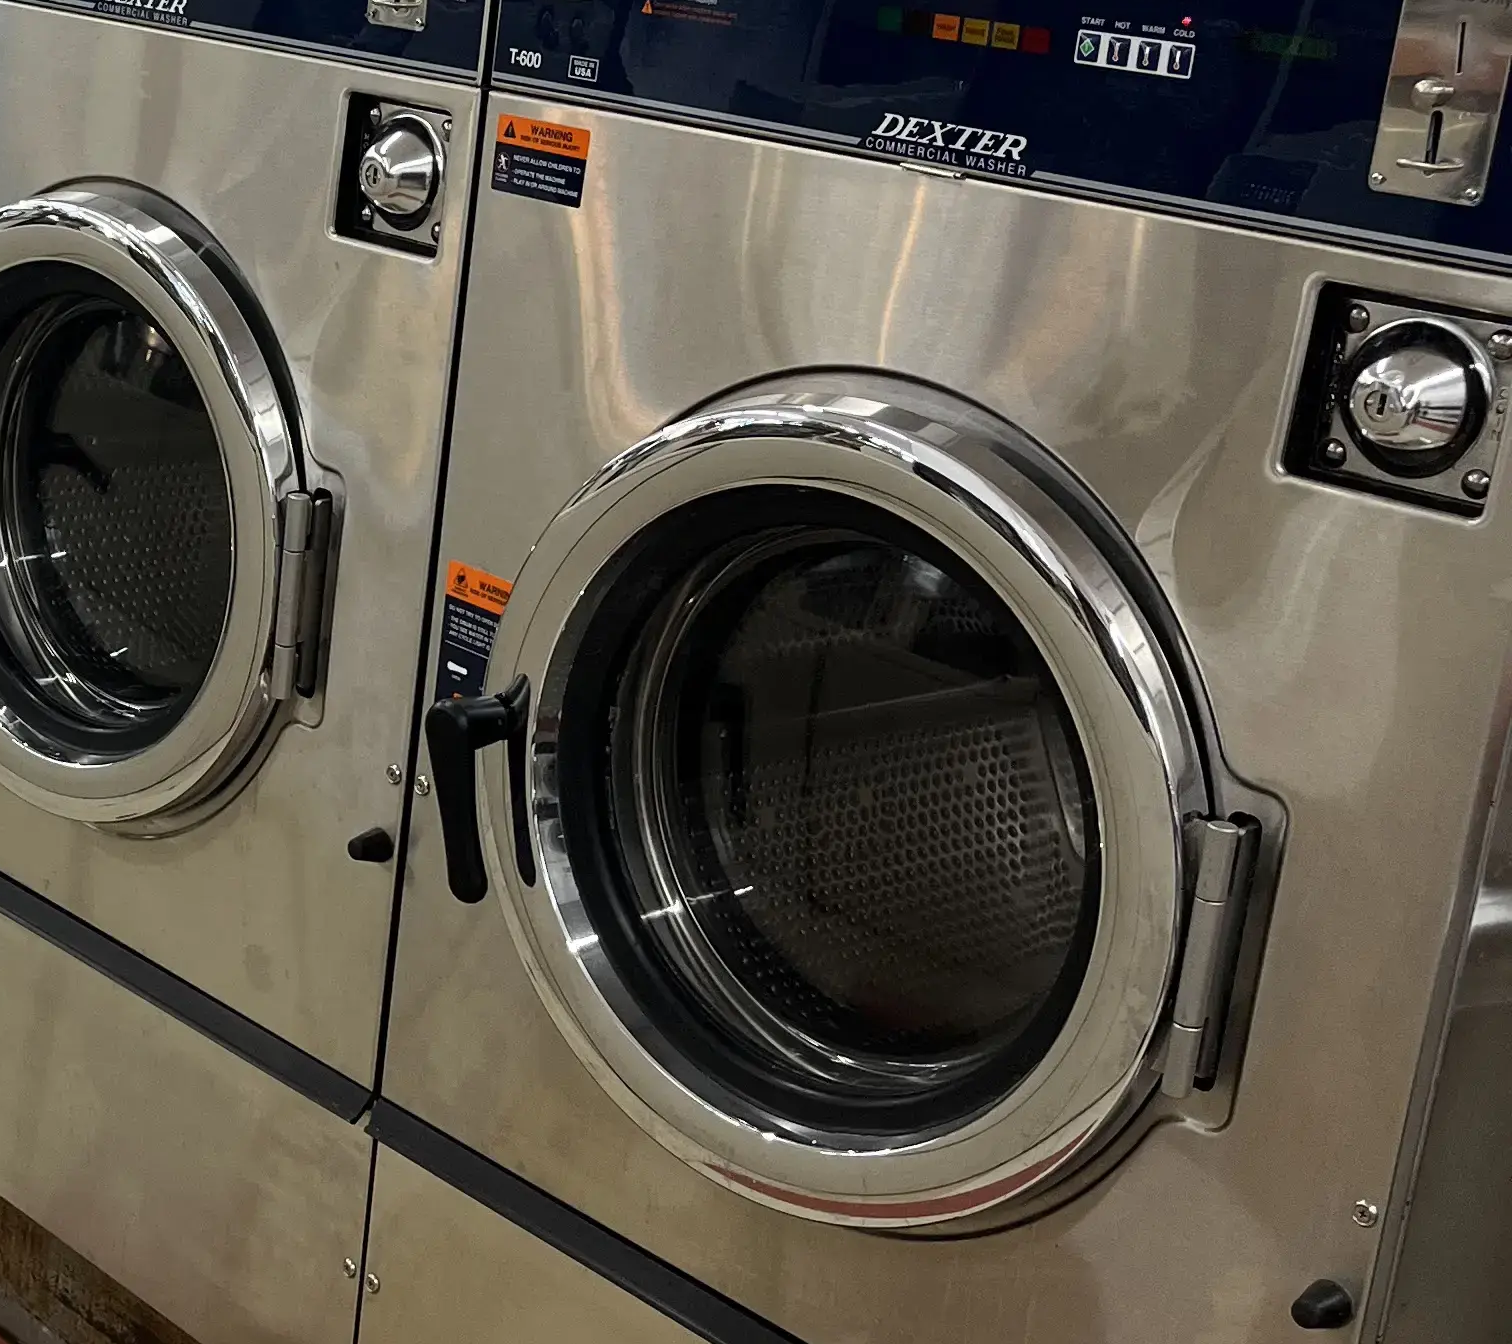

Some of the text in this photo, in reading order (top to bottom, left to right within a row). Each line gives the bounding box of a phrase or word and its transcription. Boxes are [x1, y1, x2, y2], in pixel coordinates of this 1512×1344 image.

[97, 1, 188, 26] COMMERCIAL WASHER
[1081, 16, 1106, 27] START
[1114, 21, 1131, 30] HOT
[1141, 25, 1166, 35] WARM
[1173, 29, 1196, 39] COLD
[508, 47, 542, 69] T-600
[574, 66, 592, 78] USA
[530, 124, 574, 143] WARNING
[871, 112, 1028, 161] DEXTER
[513, 154, 530, 163] NEVER
[529, 158, 548, 167] ALLOW
[547, 162, 573, 173] CHILDREN
[865, 136, 1027, 177] COMMERCIAL WASHER
